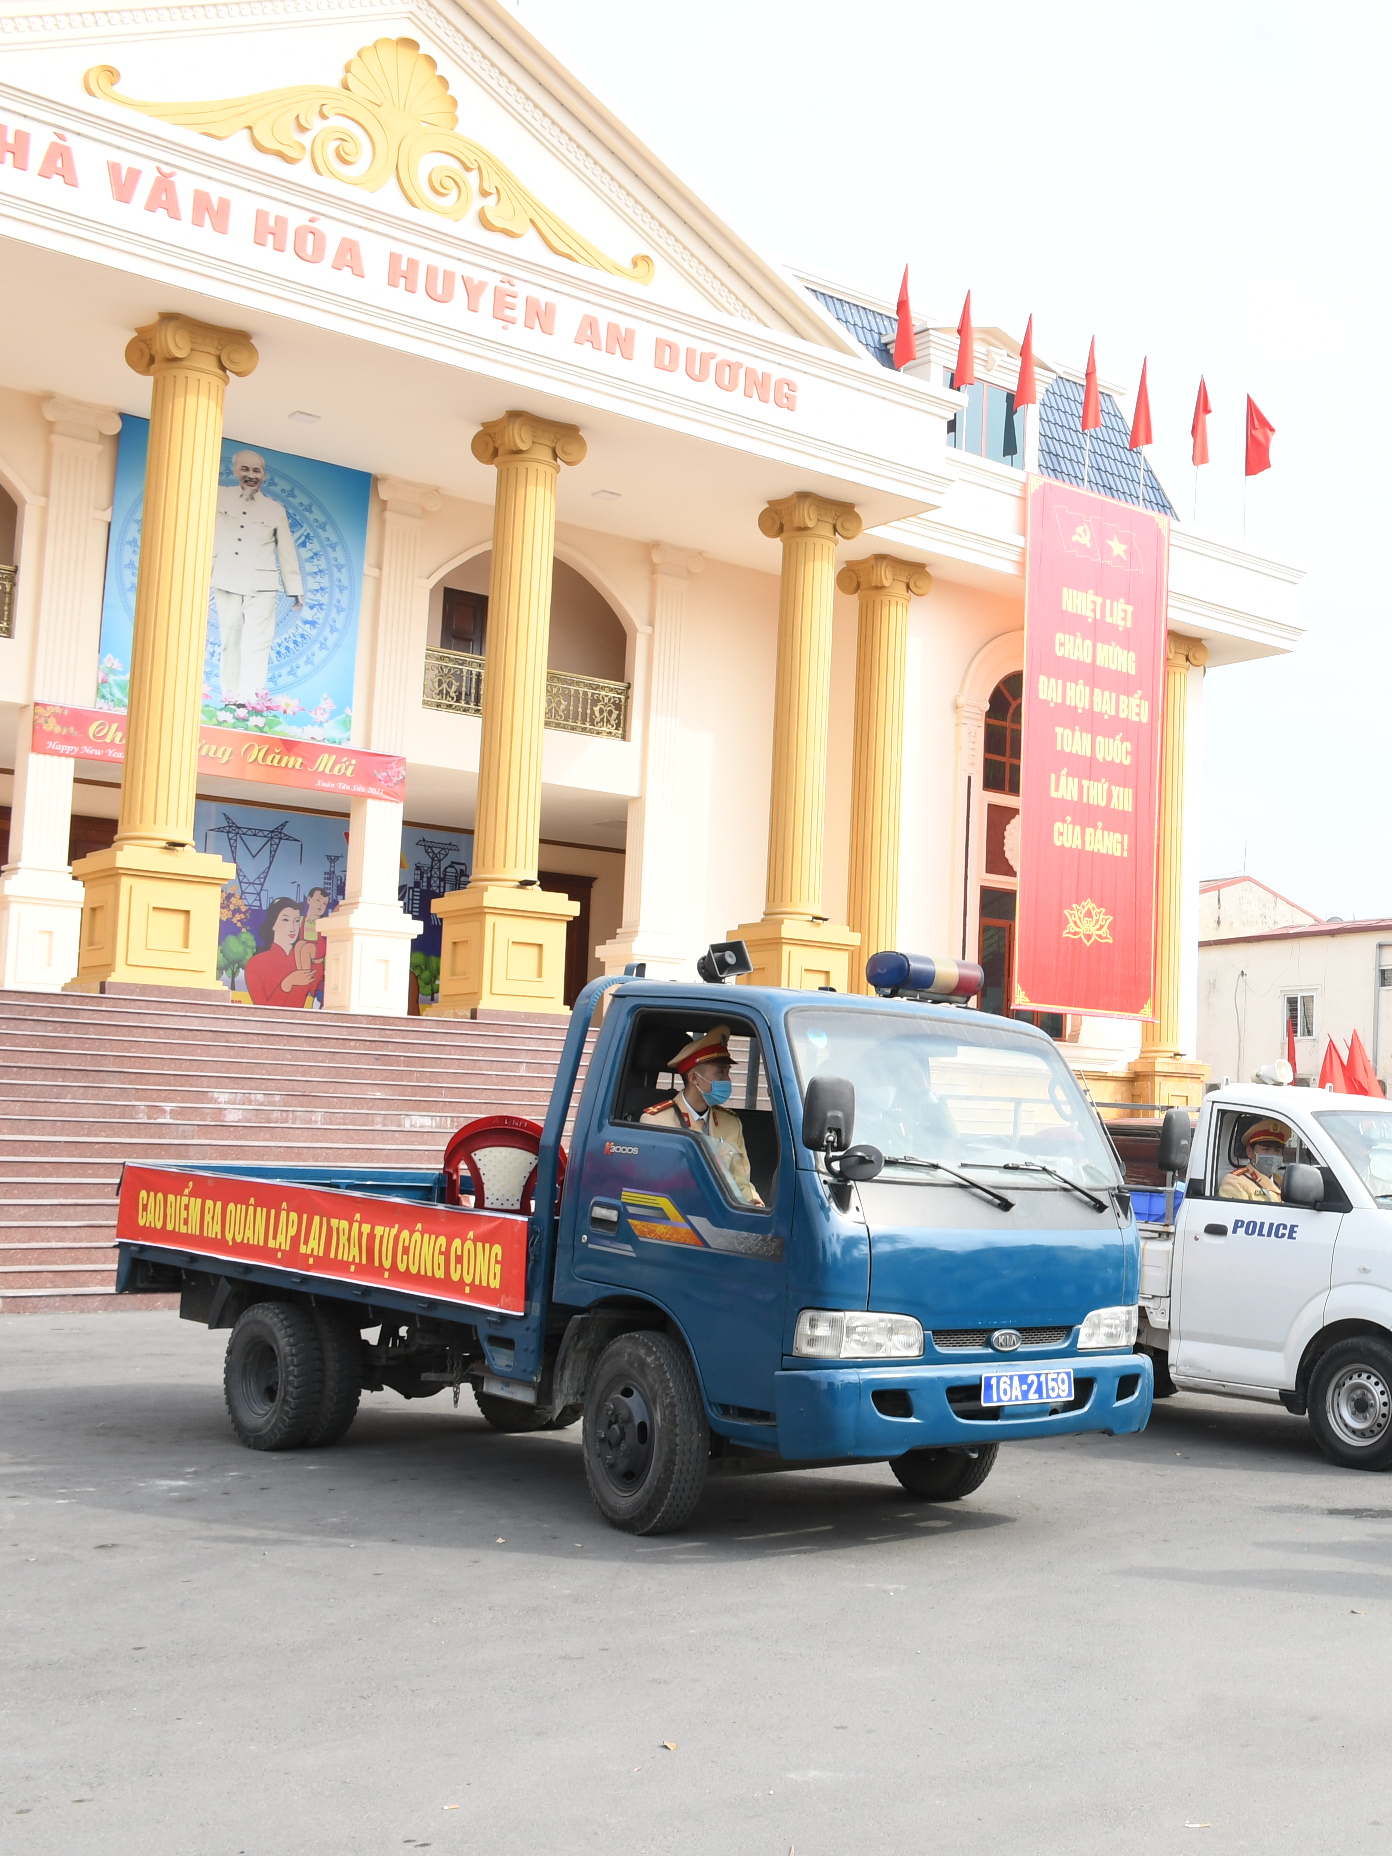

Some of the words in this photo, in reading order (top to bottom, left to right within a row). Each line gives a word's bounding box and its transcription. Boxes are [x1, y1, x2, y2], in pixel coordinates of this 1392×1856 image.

[0, 123, 79, 189] HÀ
[106, 159, 232, 235] VĂN
[253, 208, 366, 279] HÓA
[387, 251, 557, 336] HUYỆN
[573, 313, 637, 361] AN
[653, 337, 799, 412] DƯƠNG
[1061, 587, 1103, 623] NHIỆT
[1105, 598, 1134, 631] LIỆT
[1054, 632, 1093, 664] CHÀO
[1096, 641, 1136, 675] MỪNG
[1038, 674, 1062, 707] ĐẠI
[1065, 679, 1090, 713] HỘI
[1092, 687, 1117, 720] ĐẠI
[1119, 689, 1149, 724] BIỂU
[45, 741, 79, 755] Happy
[80, 745, 104, 756] New
[106, 749, 125, 759] Yea
[88, 719, 126, 745] Ch
[241, 742, 304, 770] Năm
[307, 753, 355, 778] Mới
[1054, 725, 1092, 757] TOÀN
[1095, 732, 1132, 765] QUỐC
[367, 786, 385, 795] 2021
[1050, 767, 1079, 802] LẦN
[1082, 778, 1109, 807] THỨ
[1110, 785, 1133, 812] XIII
[1053, 815, 1082, 850] CỦA
[138, 1189, 164, 1230] CAO
[166, 1181, 202, 1236] ĐIỂM
[203, 1199, 222, 1239] RA
[225, 1197, 267, 1246] QUÂN
[268, 1201, 298, 1259] LẬP
[299, 1213, 327, 1265] LẠI
[330, 1213, 371, 1273] TRẬT
[374, 1224, 399, 1279] TỰ
[397, 1222, 447, 1279] CÔNG
[450, 1231, 502, 1294] CỘNG
[1231, 1218, 1299, 1240] POLICE
[998, 1335, 1018, 1347] KIA
[990, 1372, 1069, 1402] 16A-2159
